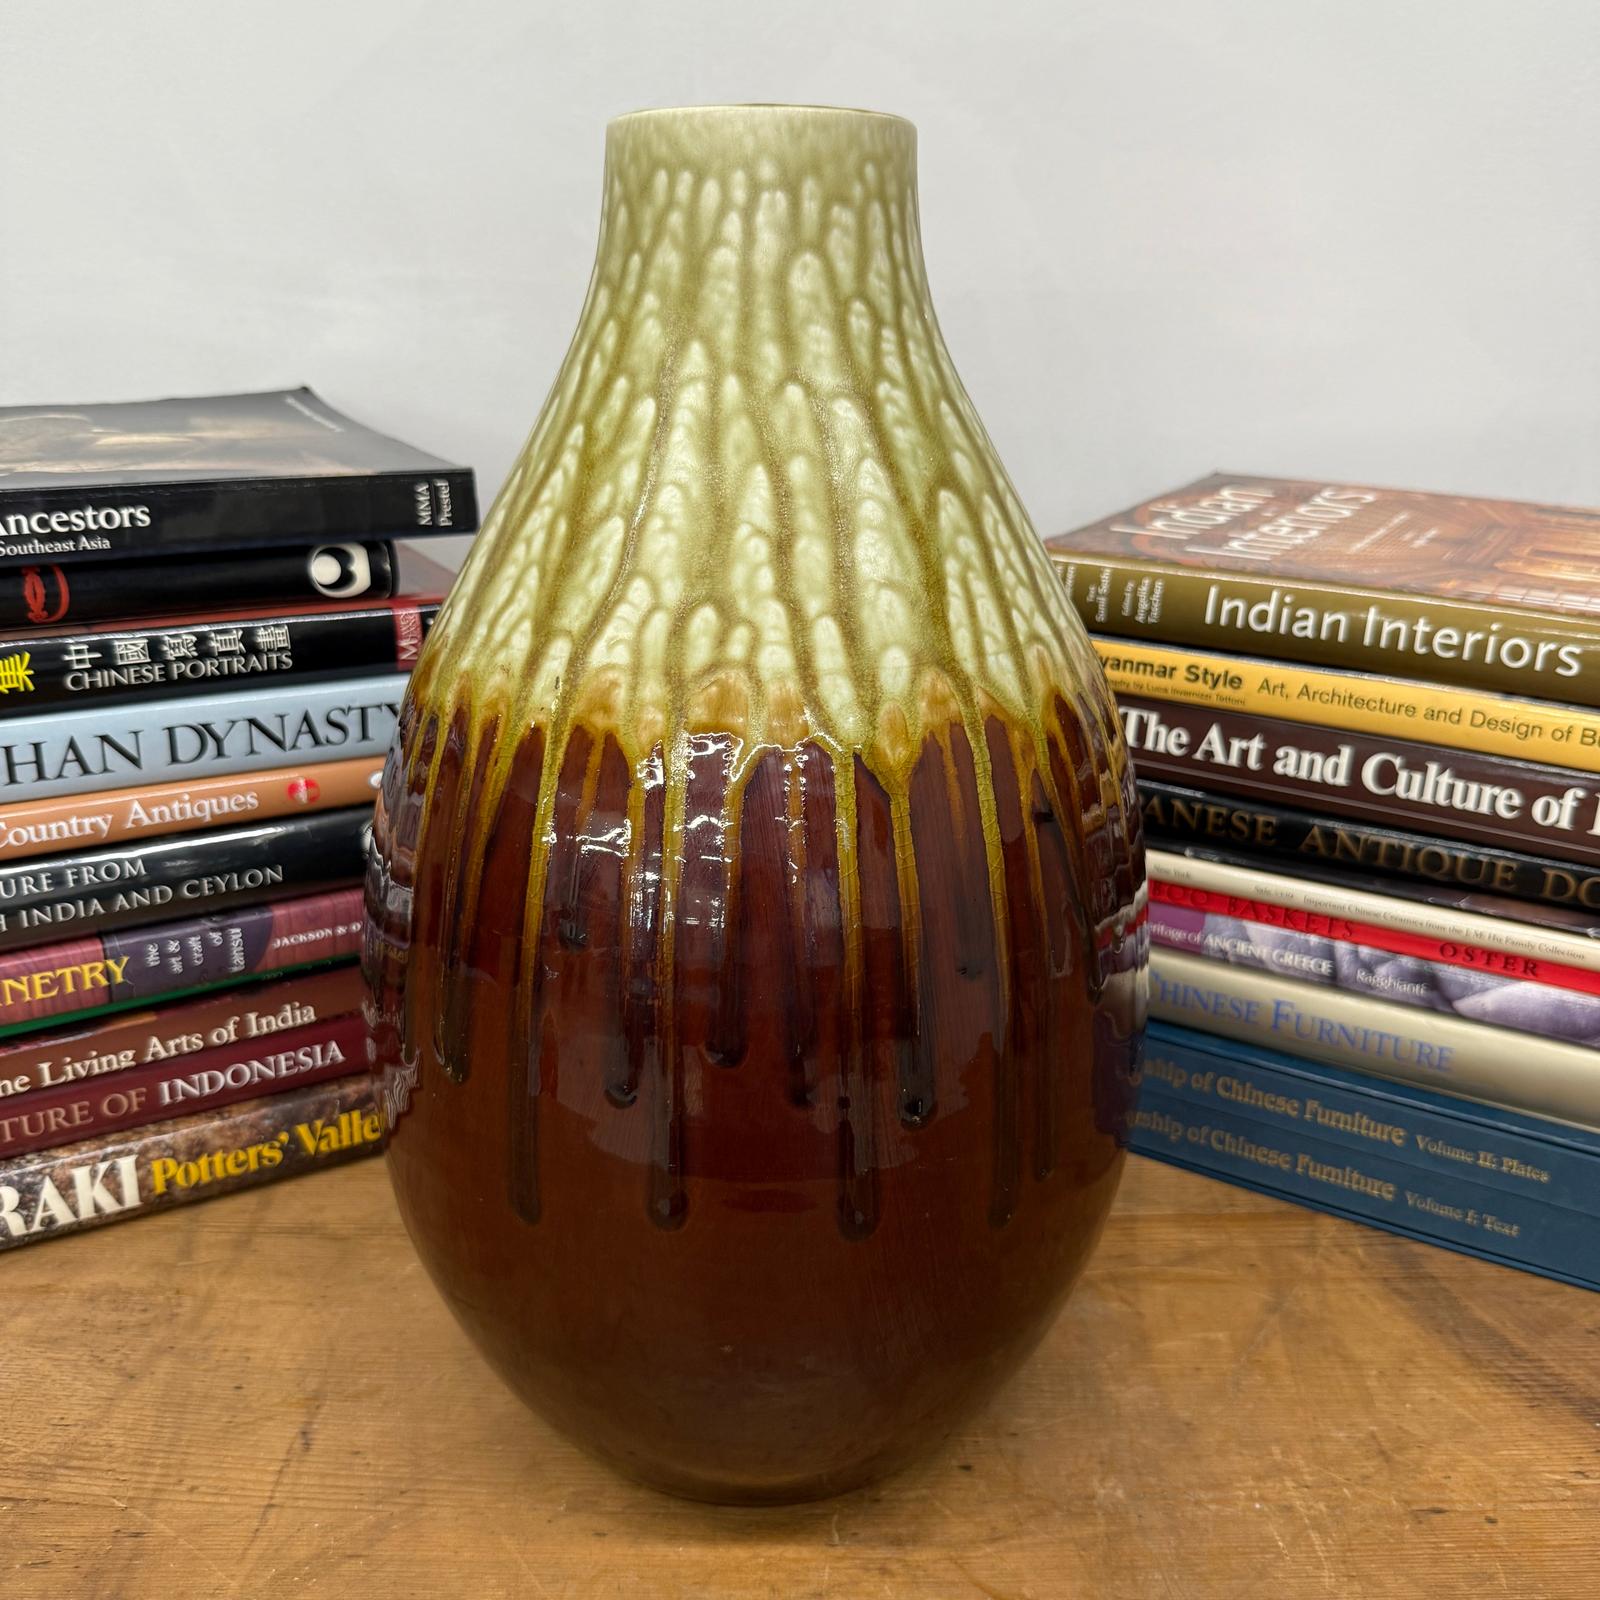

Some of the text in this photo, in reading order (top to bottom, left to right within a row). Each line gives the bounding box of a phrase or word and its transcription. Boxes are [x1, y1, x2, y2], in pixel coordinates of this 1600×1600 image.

[414, 481, 432, 526] MMA
[432, 479, 453, 527] Prestel
[1108, 485, 1275, 540] Indian
[78, 534, 111, 550] Asia
[1204, 583, 1584, 677] Indian Interiors
[65, 651, 293, 691] CHINESE PORTRAITS
[1184, 663, 1243, 691] Style
[1257, 677, 1289, 701] Art,
[1296, 684, 1416, 718] Architecture
[1423, 707, 1462, 725] and
[1469, 710, 1543, 740] Design
[1551, 726, 1573, 742] of
[0, 730, 144, 785] HAN
[1119, 706, 1191, 757] The
[1192, 722, 1267, 771] Art
[1273, 744, 1354, 787] and
[1361, 752, 1523, 819] Culture
[1531, 787, 1587, 830] of
[125, 790, 259, 829] Antiques
[1139, 795, 1279, 846] ANESE
[1300, 825, 1518, 890] ANTIQUE
[19, 898, 105, 929] INDIA
[113, 885, 173, 912] AND
[180, 864, 284, 899] CEYLON
[66, 859, 146, 888] FROM
[272, 927, 333, 949] JACKSON
[335, 924, 348, 936] &
[1228, 896, 1354, 938] BASKETS
[0, 956, 129, 1006] NETRY
[1203, 933, 1269, 960] ANCIENT
[1272, 949, 1334, 976] GREECE
[1439, 942, 1539, 977] OSTER
[38, 1050, 136, 1088] Living
[143, 1032, 204, 1063] Arts
[208, 1016, 240, 1047] of
[244, 1001, 317, 1037] India
[1272, 998, 1456, 1071] FURNITURE
[0, 1040, 346, 1143] TURE OF INDONESIA
[1191, 1071, 1215, 1092] of
[1216, 1076, 1299, 1117] Chinese
[1304, 1099, 1408, 1146] Furniture
[1415, 1134, 1473, 1164] Volume
[1502, 1156, 1552, 1183] Plates
[152, 1131, 289, 1196] Potters'
[1187, 1125, 1210, 1144] of
[1210, 1129, 1292, 1171] Chinese
[1296, 1152, 1397, 1201] Furniture
[1405, 1190, 1464, 1221] Volume
